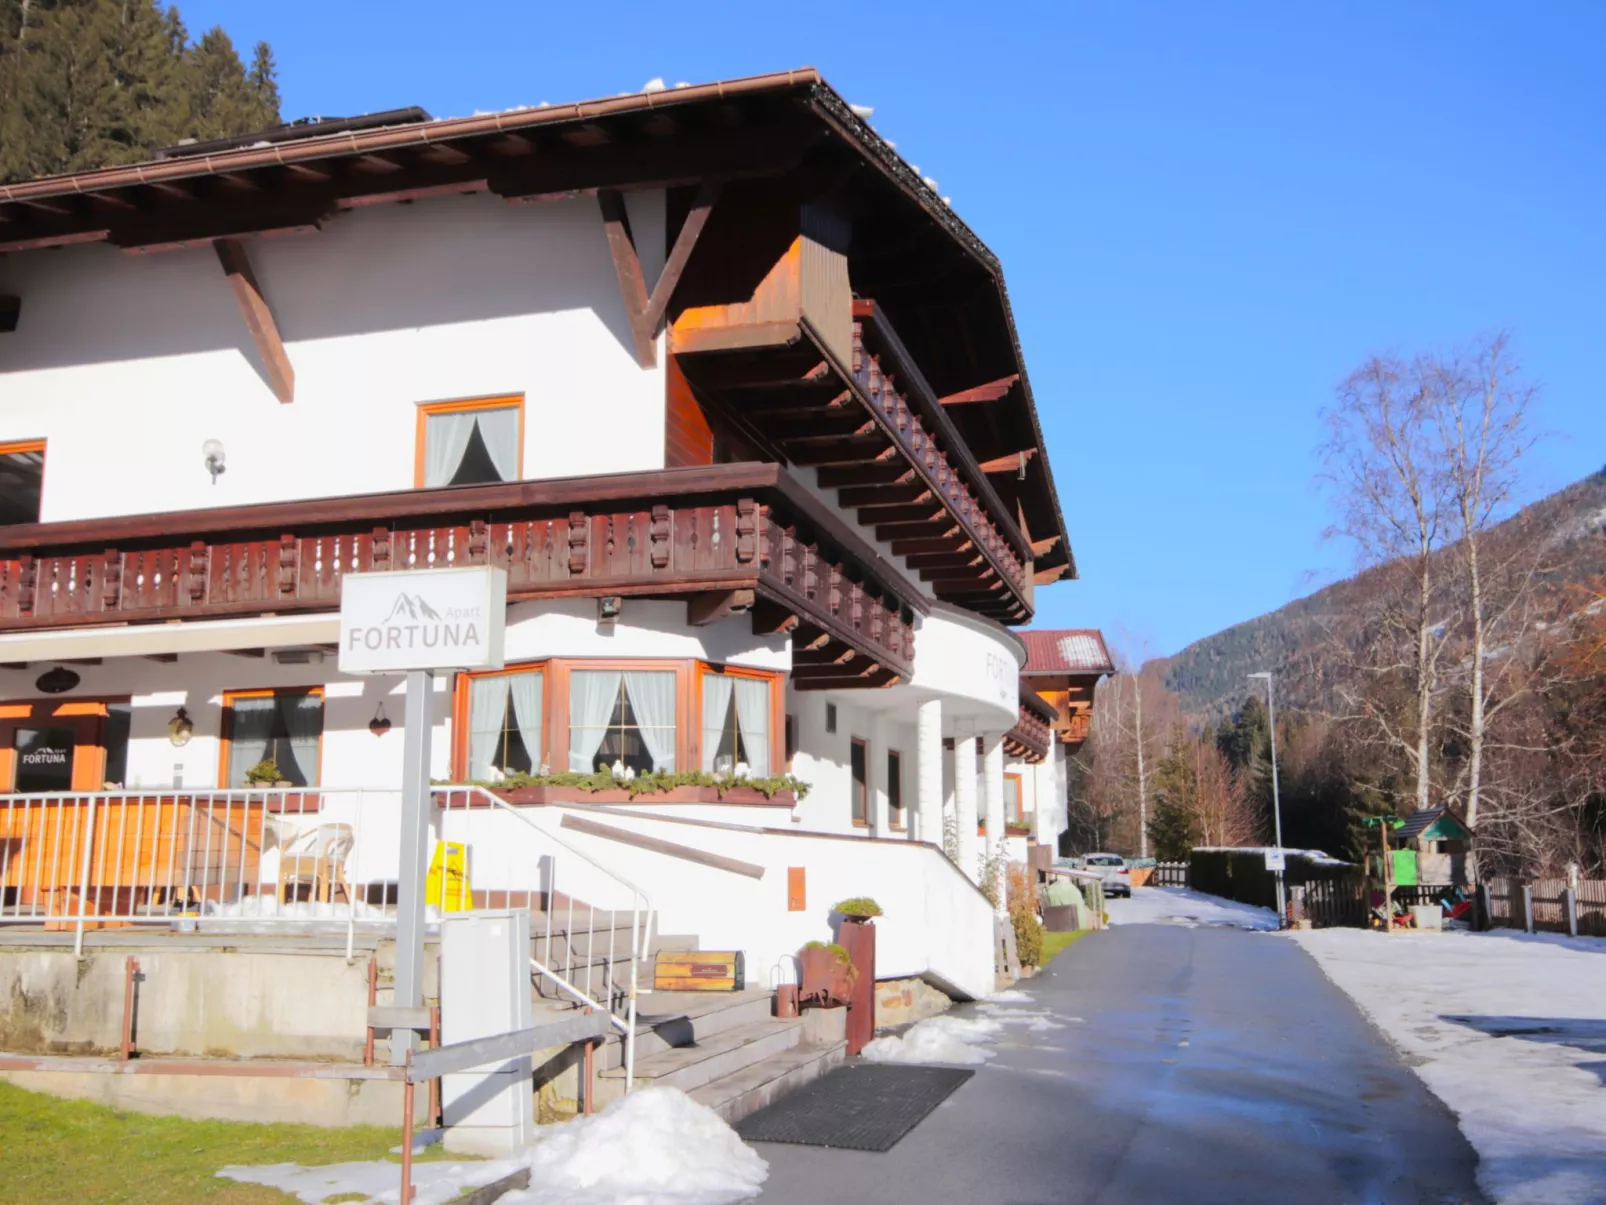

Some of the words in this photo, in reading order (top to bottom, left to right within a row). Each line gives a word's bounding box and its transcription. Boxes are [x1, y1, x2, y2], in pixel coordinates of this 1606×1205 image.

[445, 607, 480, 620] Apart
[349, 623, 480, 651] FORTUNA
[23, 754, 66, 764] FORTUNA
